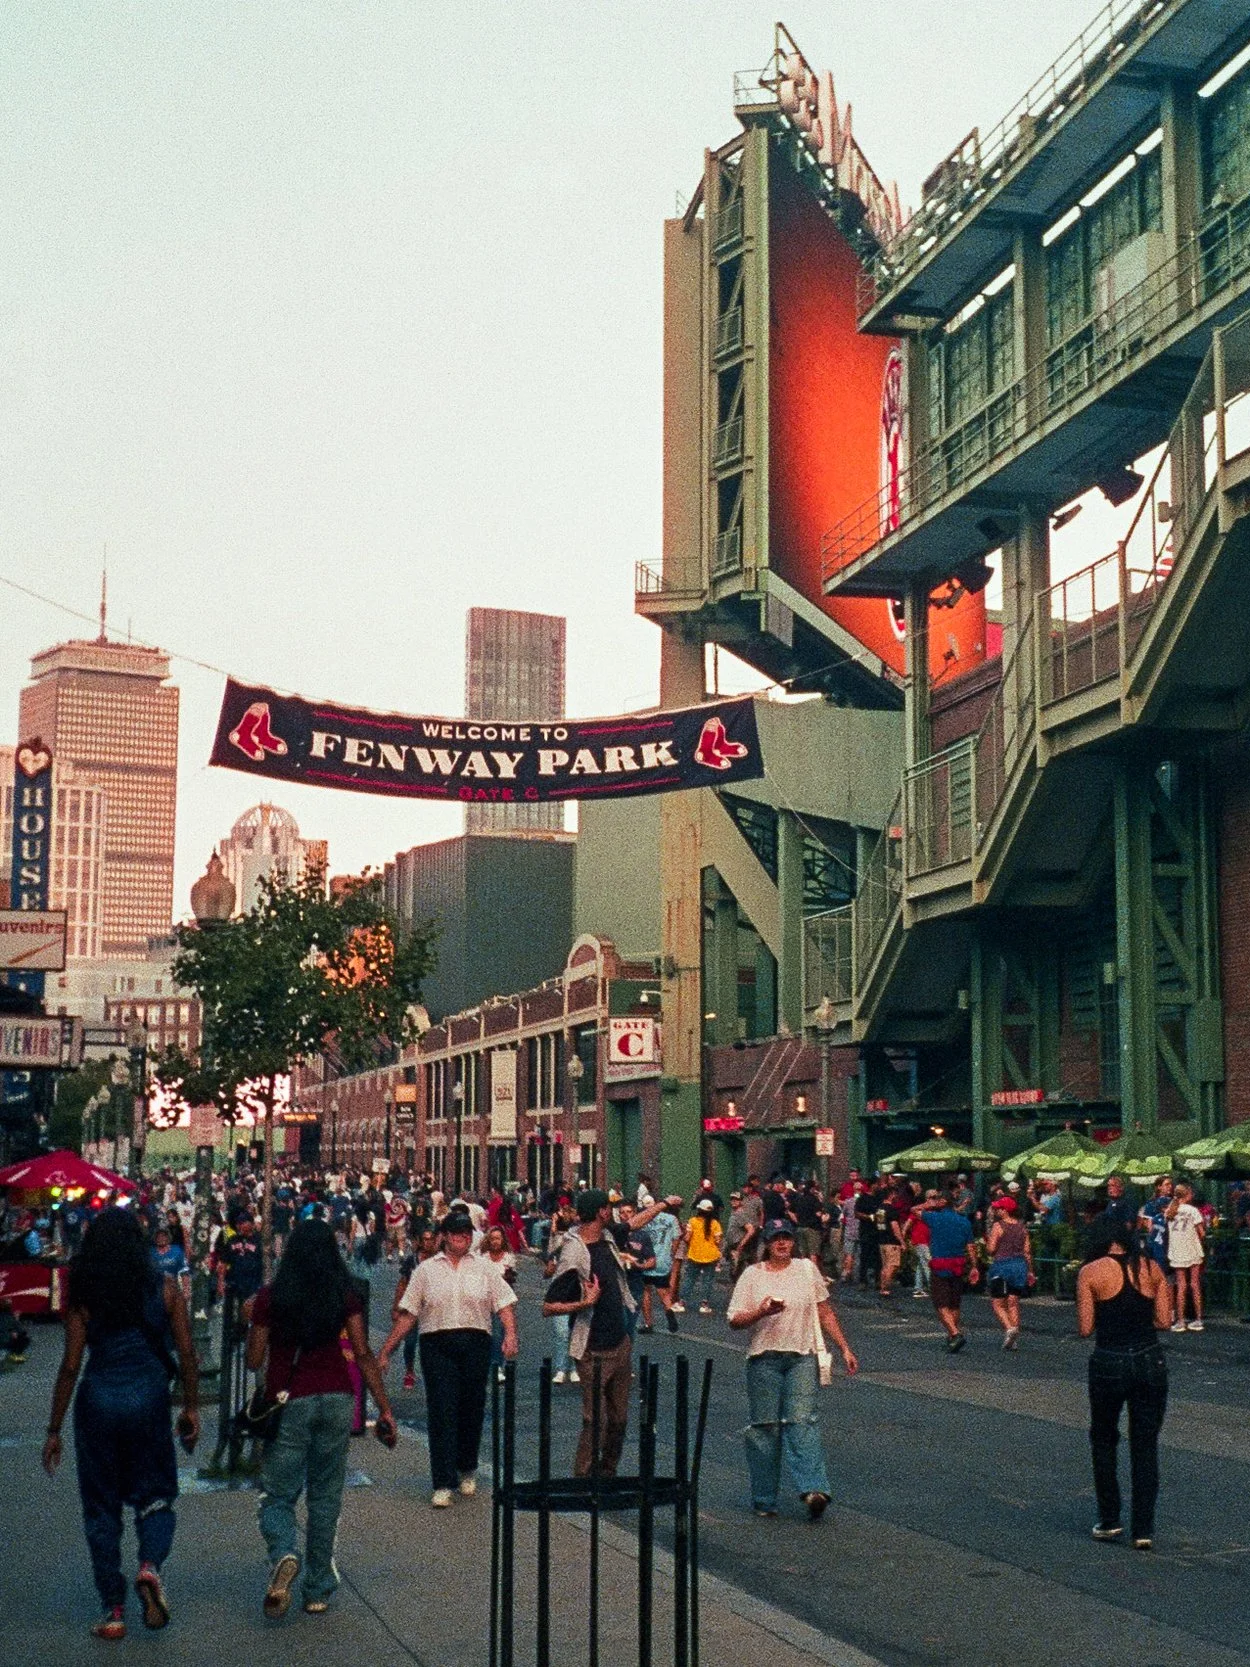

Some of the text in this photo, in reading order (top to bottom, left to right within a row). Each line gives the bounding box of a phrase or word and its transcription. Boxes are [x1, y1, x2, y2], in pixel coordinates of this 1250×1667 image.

[422, 722, 569, 741] WELCOME TO
[309, 731, 679, 779] FENWAY PARK
[458, 786, 514, 800] GATE
[19, 786, 45, 911] HOUSE
[613, 1021, 648, 1029] GATE
[617, 1032, 644, 1057] C
